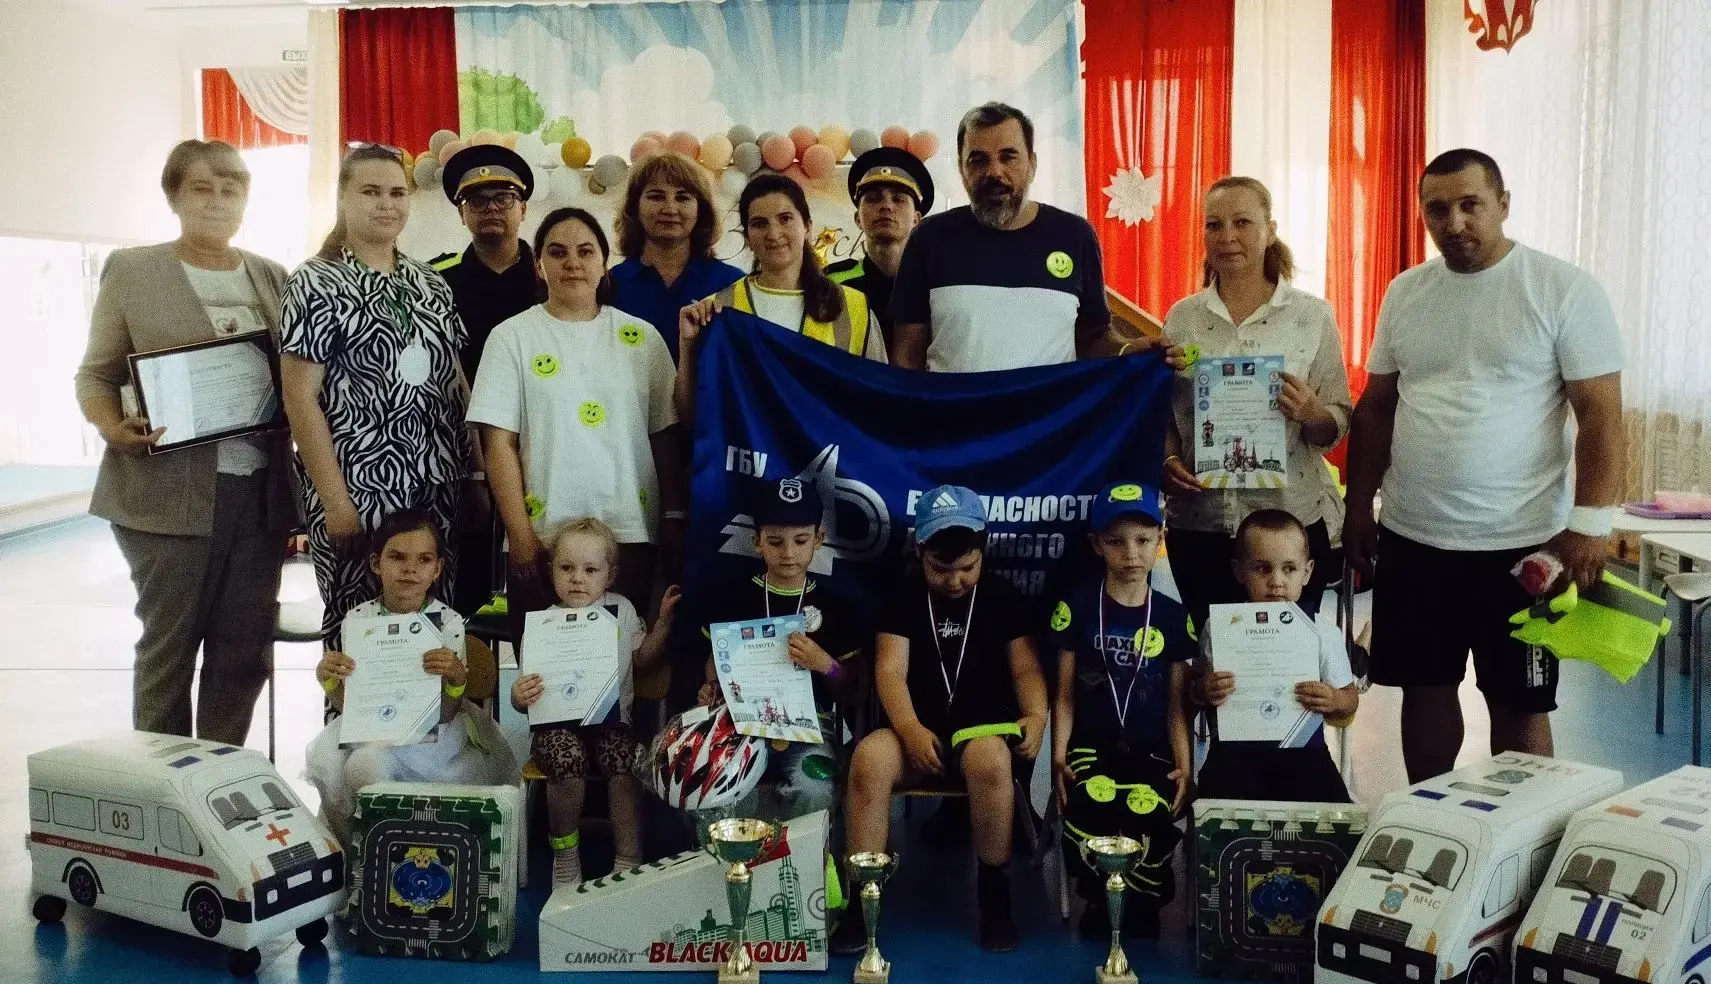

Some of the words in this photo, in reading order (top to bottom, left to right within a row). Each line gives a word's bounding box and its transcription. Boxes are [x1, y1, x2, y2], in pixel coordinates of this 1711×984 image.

[285, 50, 308, 61] ВЫХ
[725, 445, 768, 478] ГБУ
[1245, 628, 1280, 636] ГРАМОТА
[376, 638, 409, 646] ГРАМОТА
[743, 642, 776, 650] ГРАМОТА
[111, 809, 130, 831] 03
[1413, 894, 1441, 909] МЧС
[1630, 929, 1647, 940] 02
[564, 951, 636, 965] САМОКАТ
[648, 941, 730, 964] BLACK
